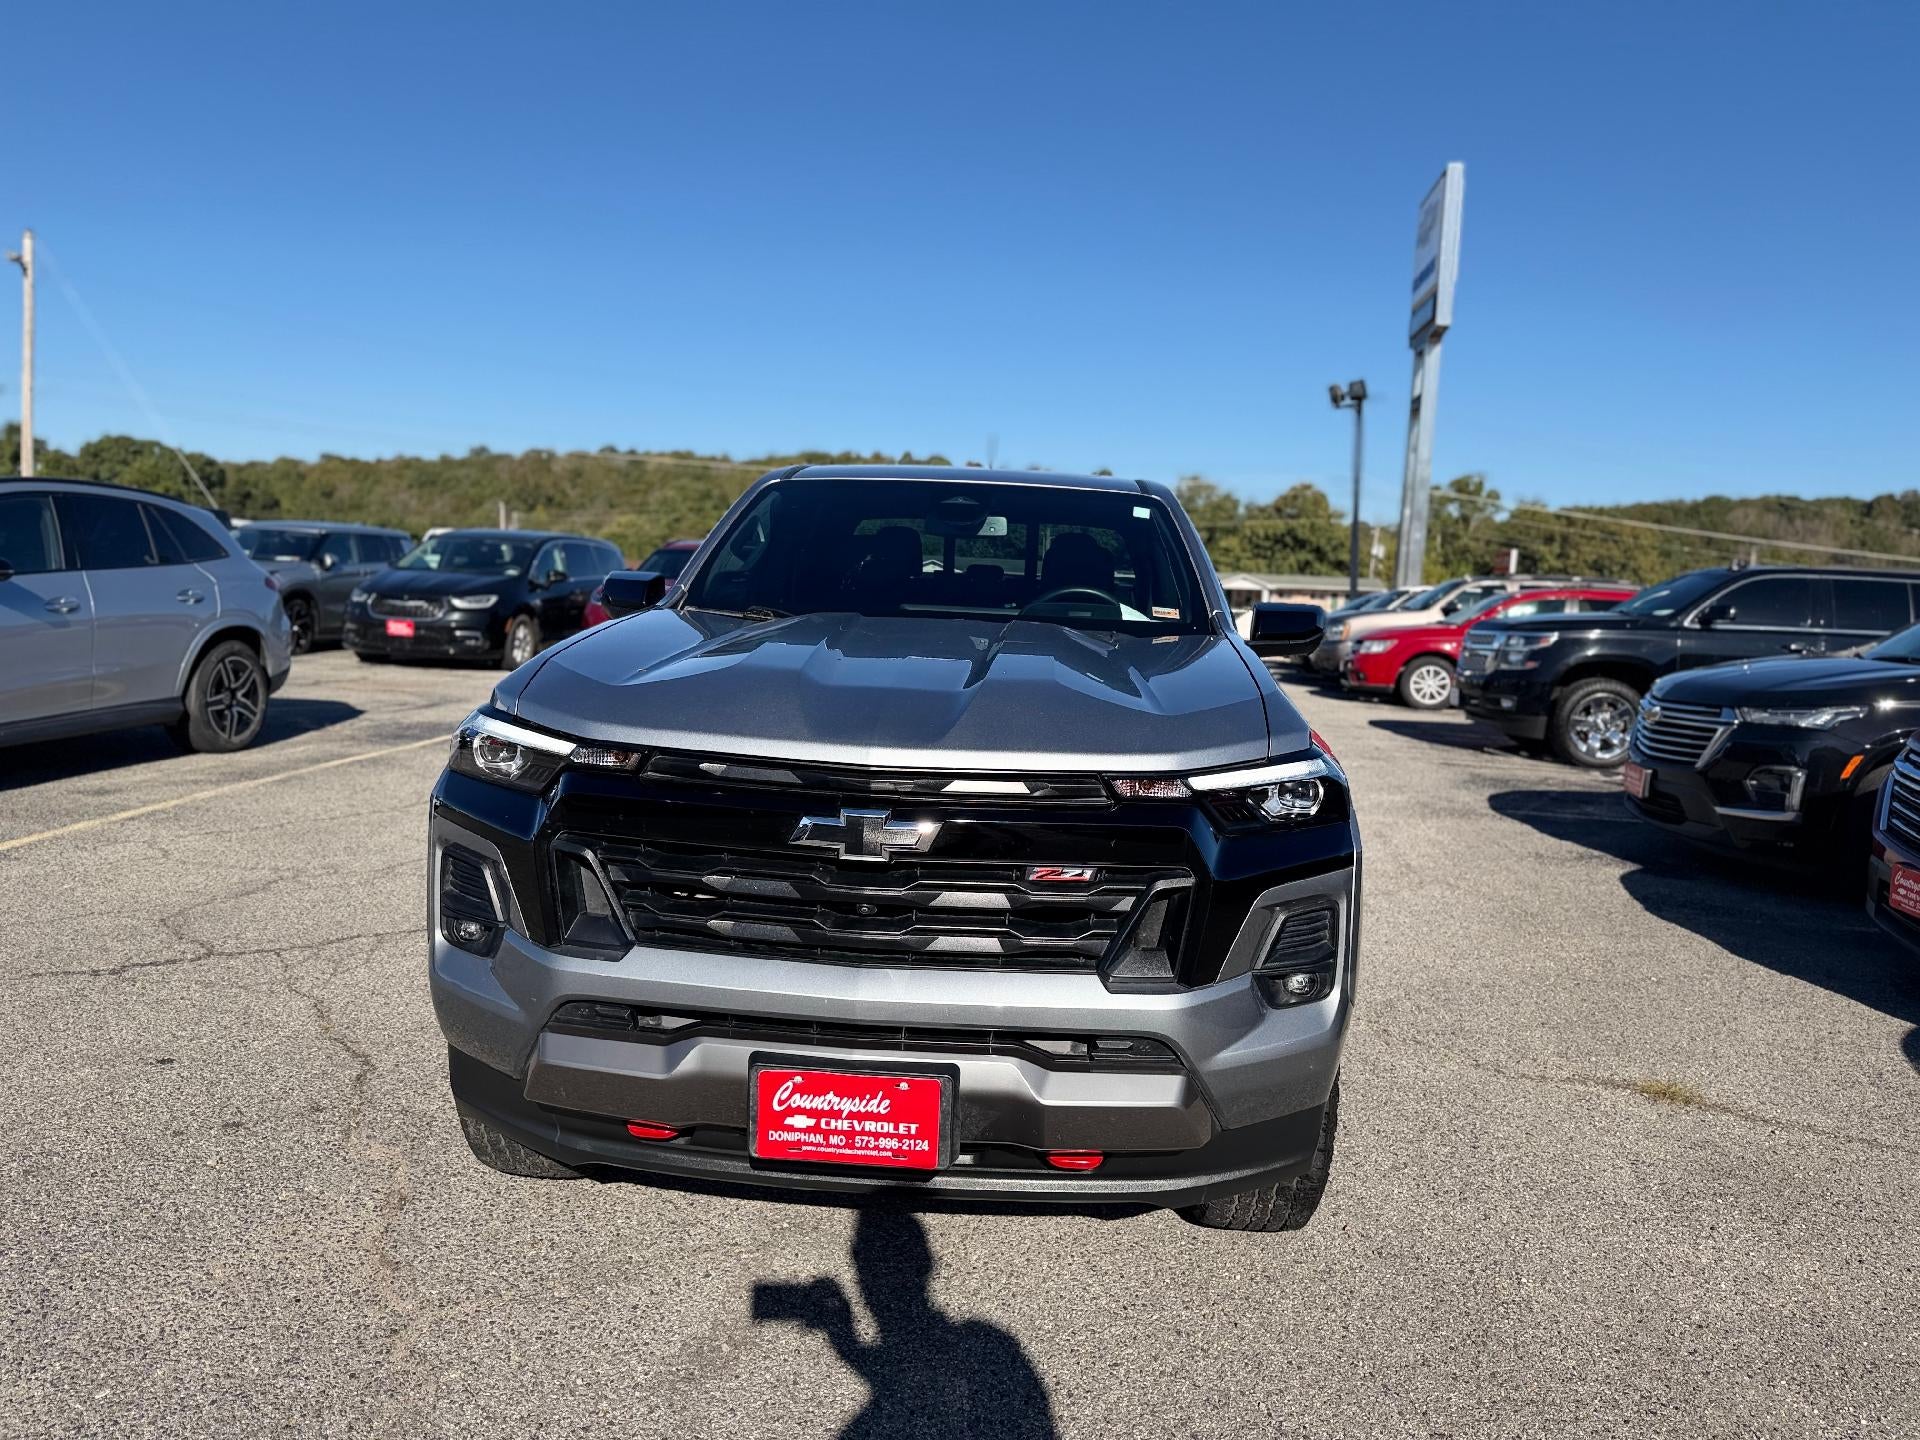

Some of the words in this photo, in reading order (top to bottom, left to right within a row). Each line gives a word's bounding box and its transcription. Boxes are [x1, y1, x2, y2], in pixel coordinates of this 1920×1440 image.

[1028, 866, 1097, 881] Z71
[772, 1081, 891, 1119] Countryside
[820, 1118, 920, 1135] CHEVROLET
[768, 1130, 827, 1146] DONIPHAN,
[829, 1134, 846, 1146] MO
[854, 1135, 930, 1151] 573-996-2124
